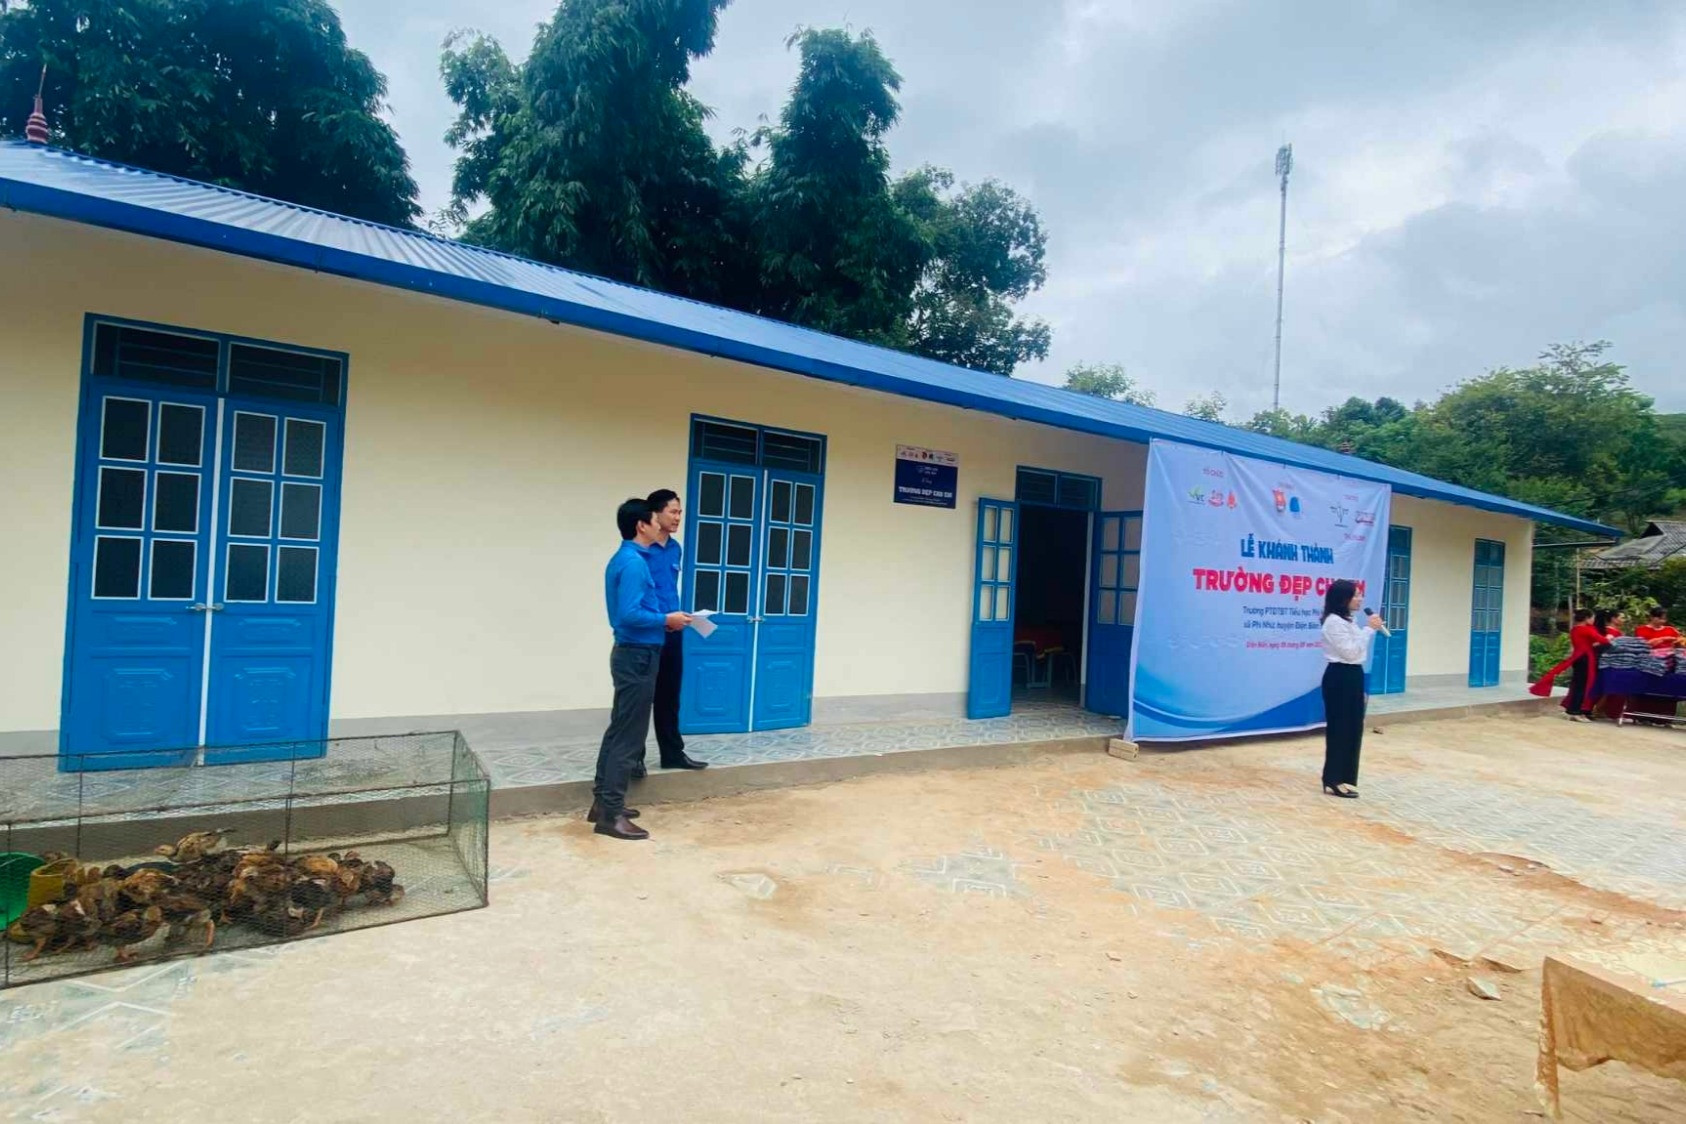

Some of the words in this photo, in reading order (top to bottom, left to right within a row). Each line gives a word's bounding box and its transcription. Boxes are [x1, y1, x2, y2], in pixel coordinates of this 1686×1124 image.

[1241, 533, 1255, 558] LỄ
[1258, 539, 1298, 562] KHÁNH
[1301, 542, 1335, 565] THÀNH
[1193, 566, 1275, 594] TRƯỜNG
[1279, 574, 1312, 601] ĐẸP
[1315, 577, 1335, 597] CH
